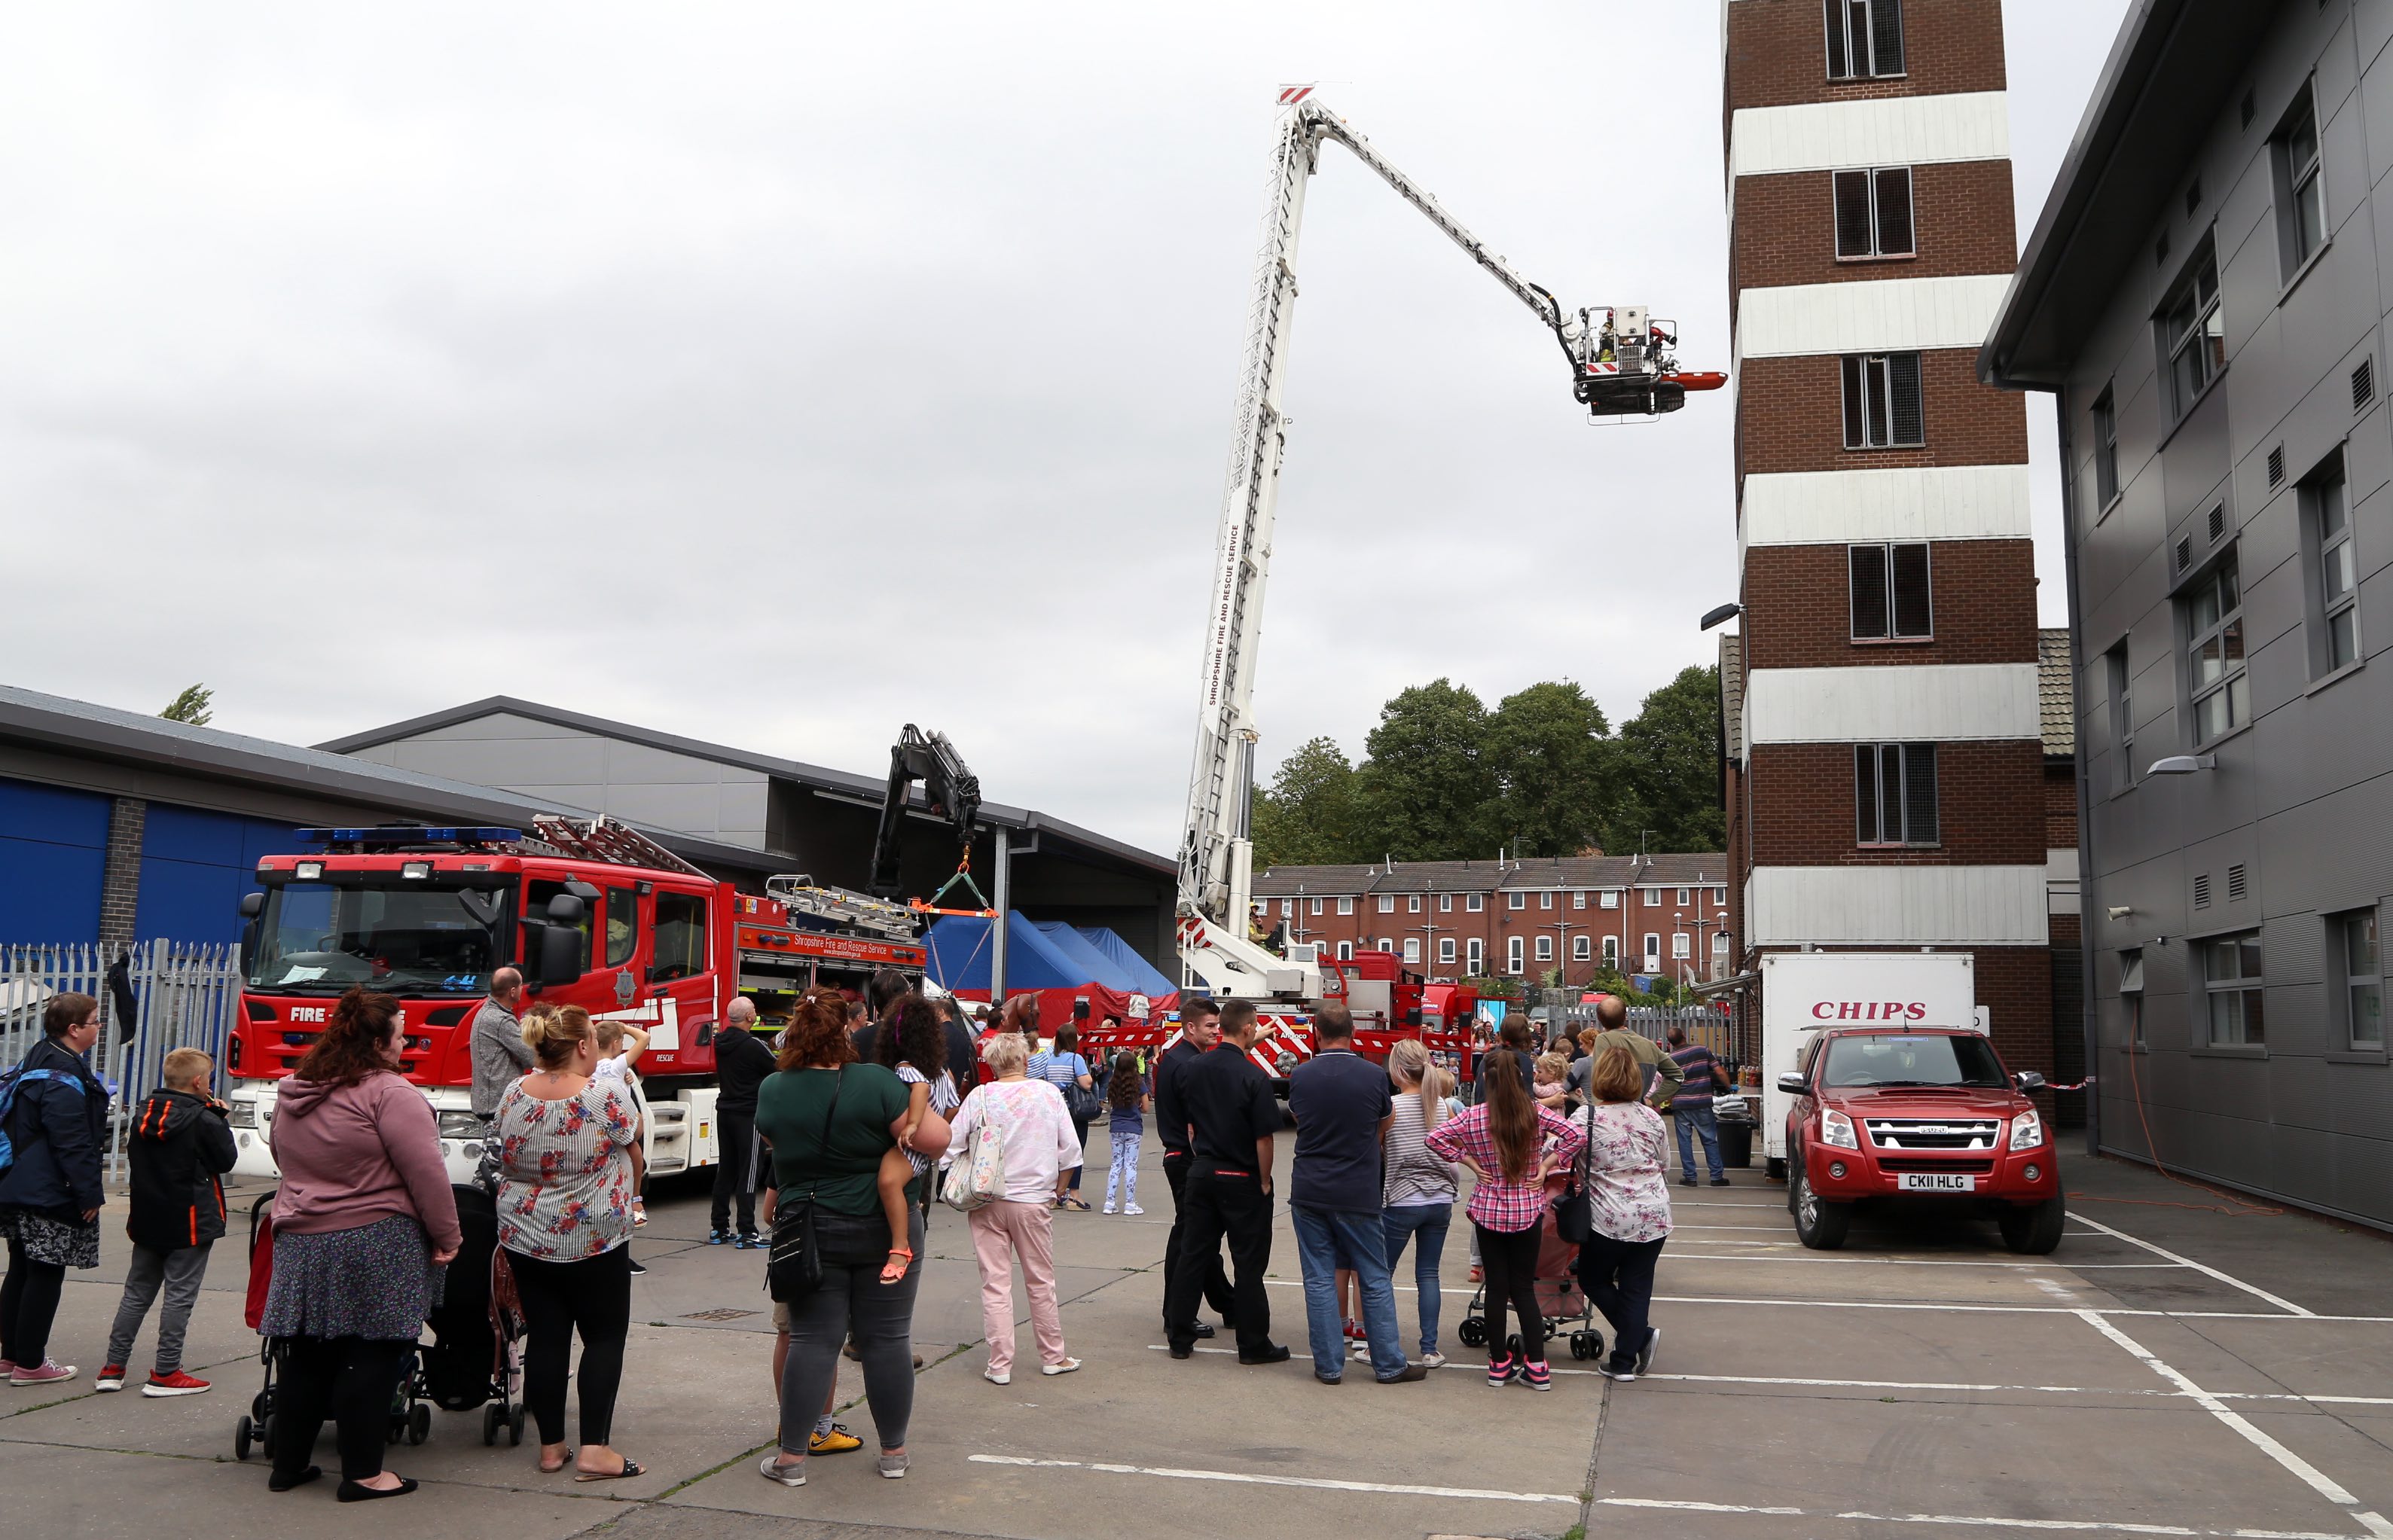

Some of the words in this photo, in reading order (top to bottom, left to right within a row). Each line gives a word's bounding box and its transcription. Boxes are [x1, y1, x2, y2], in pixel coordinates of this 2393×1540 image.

[1228, 524, 1239, 563] SERVICE
[1222, 565, 1234, 601] RESCUE
[1220, 603, 1229, 622] AND
[1217, 624, 1225, 645] FIRE
[1209, 647, 1222, 706] SHROPSHIRE
[794, 934, 824, 949] Shropshire
[825, 938, 836, 949] Fire
[837, 941, 847, 950] and
[848, 941, 867, 953] Rescue
[868, 943, 887, 955] Service
[290, 1007, 326, 1023] FIRE
[1812, 1002, 1926, 1020] CHIPS
[1909, 1175, 1934, 1188] CK11
[1937, 1176, 1964, 1188] HLG
